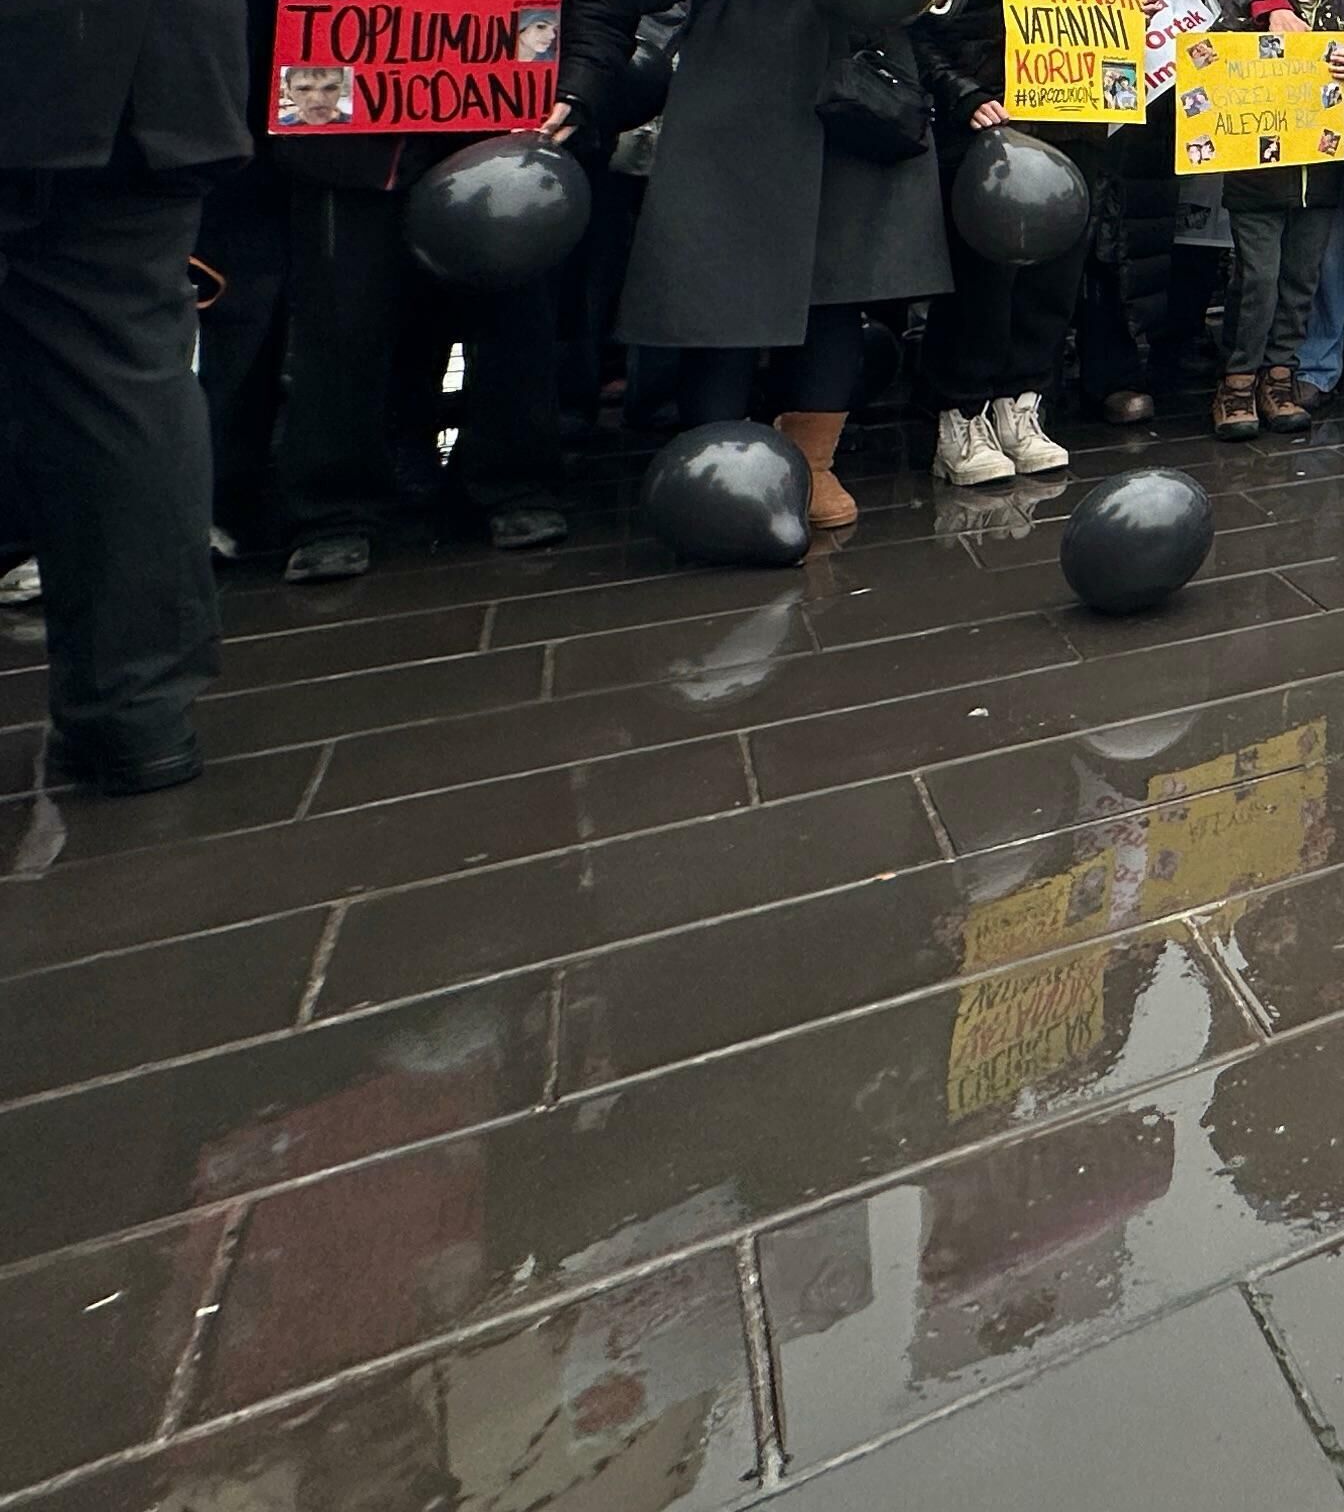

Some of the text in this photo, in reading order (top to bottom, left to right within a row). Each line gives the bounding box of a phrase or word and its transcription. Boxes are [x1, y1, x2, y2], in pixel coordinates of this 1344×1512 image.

[284, 4, 519, 65] TOPLUMUN
[1010, 5, 1130, 51] VATANINI
[1146, 10, 1207, 50] Ortak
[1015, 49, 1096, 88] KORU!
